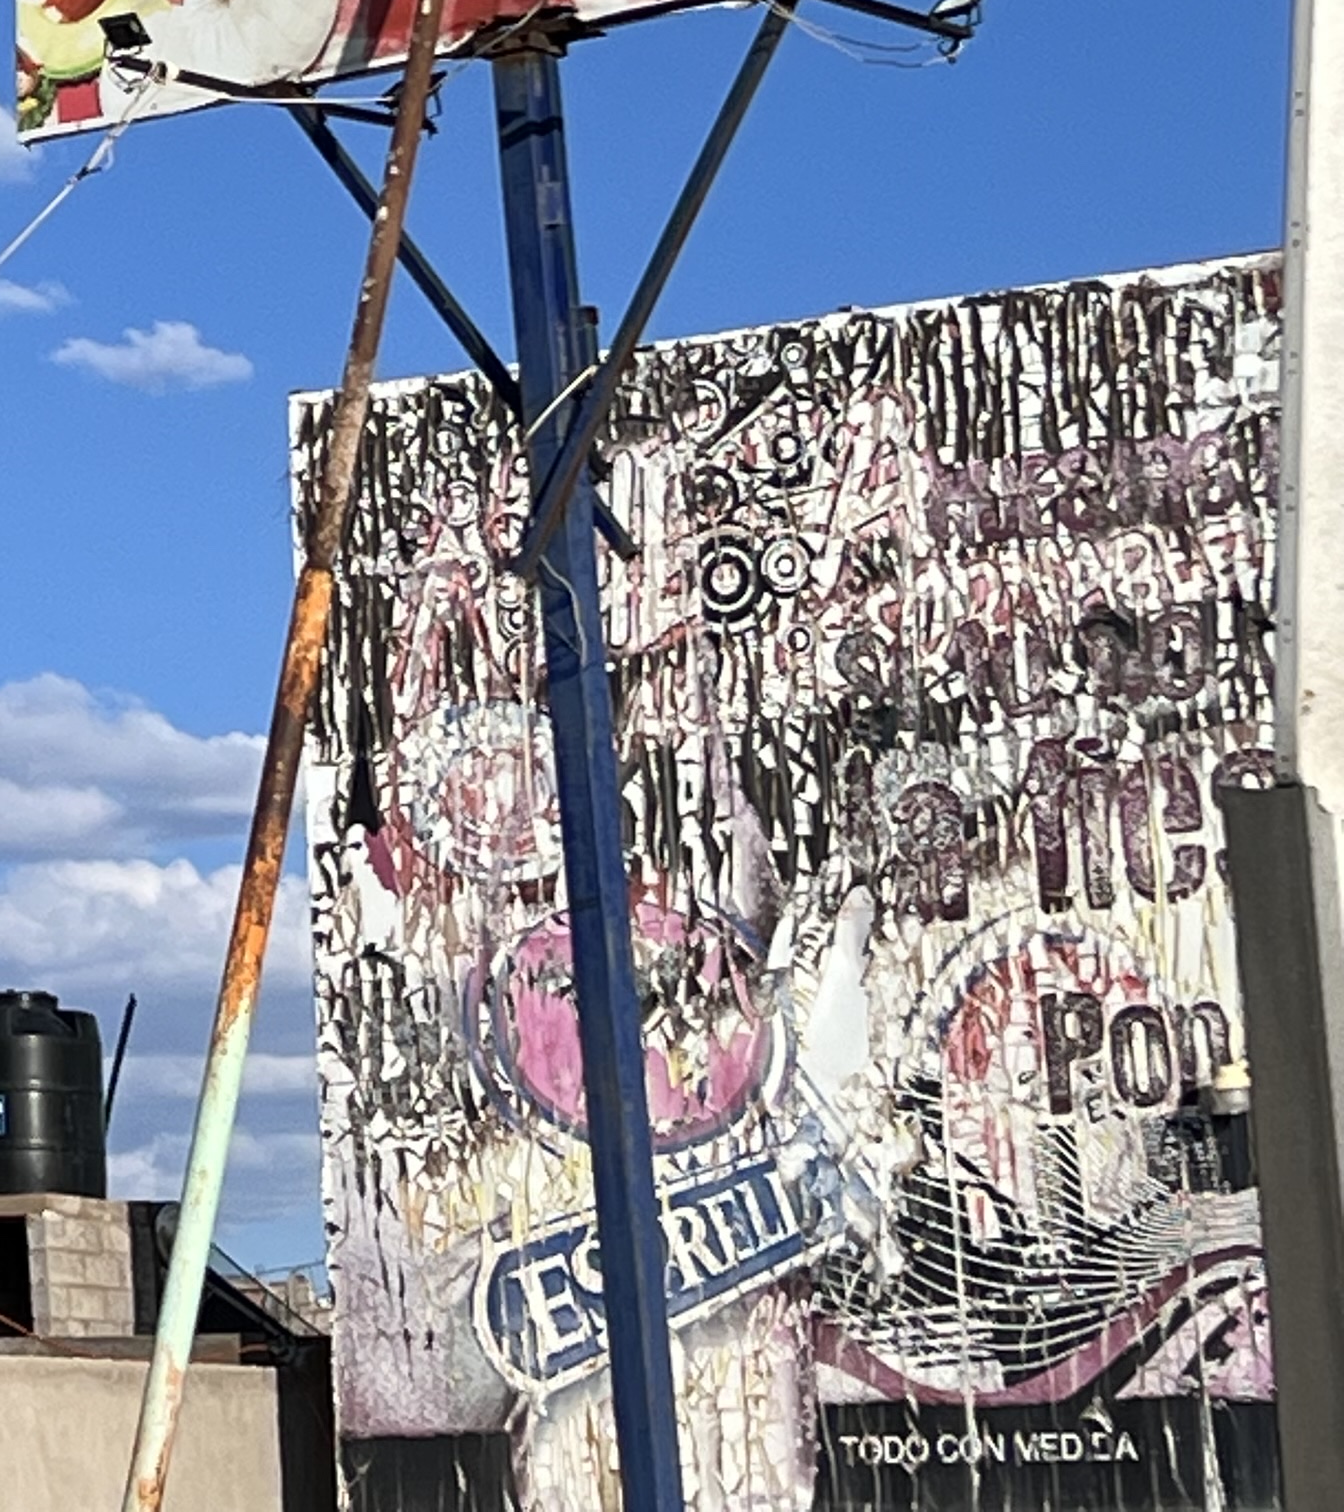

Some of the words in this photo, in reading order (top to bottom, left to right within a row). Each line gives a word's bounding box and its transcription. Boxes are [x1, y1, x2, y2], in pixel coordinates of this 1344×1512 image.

[839, 1431, 930, 1466] TODO
[936, 1432, 1006, 1465] CON
[1014, 1430, 1140, 1465] MEDDA
